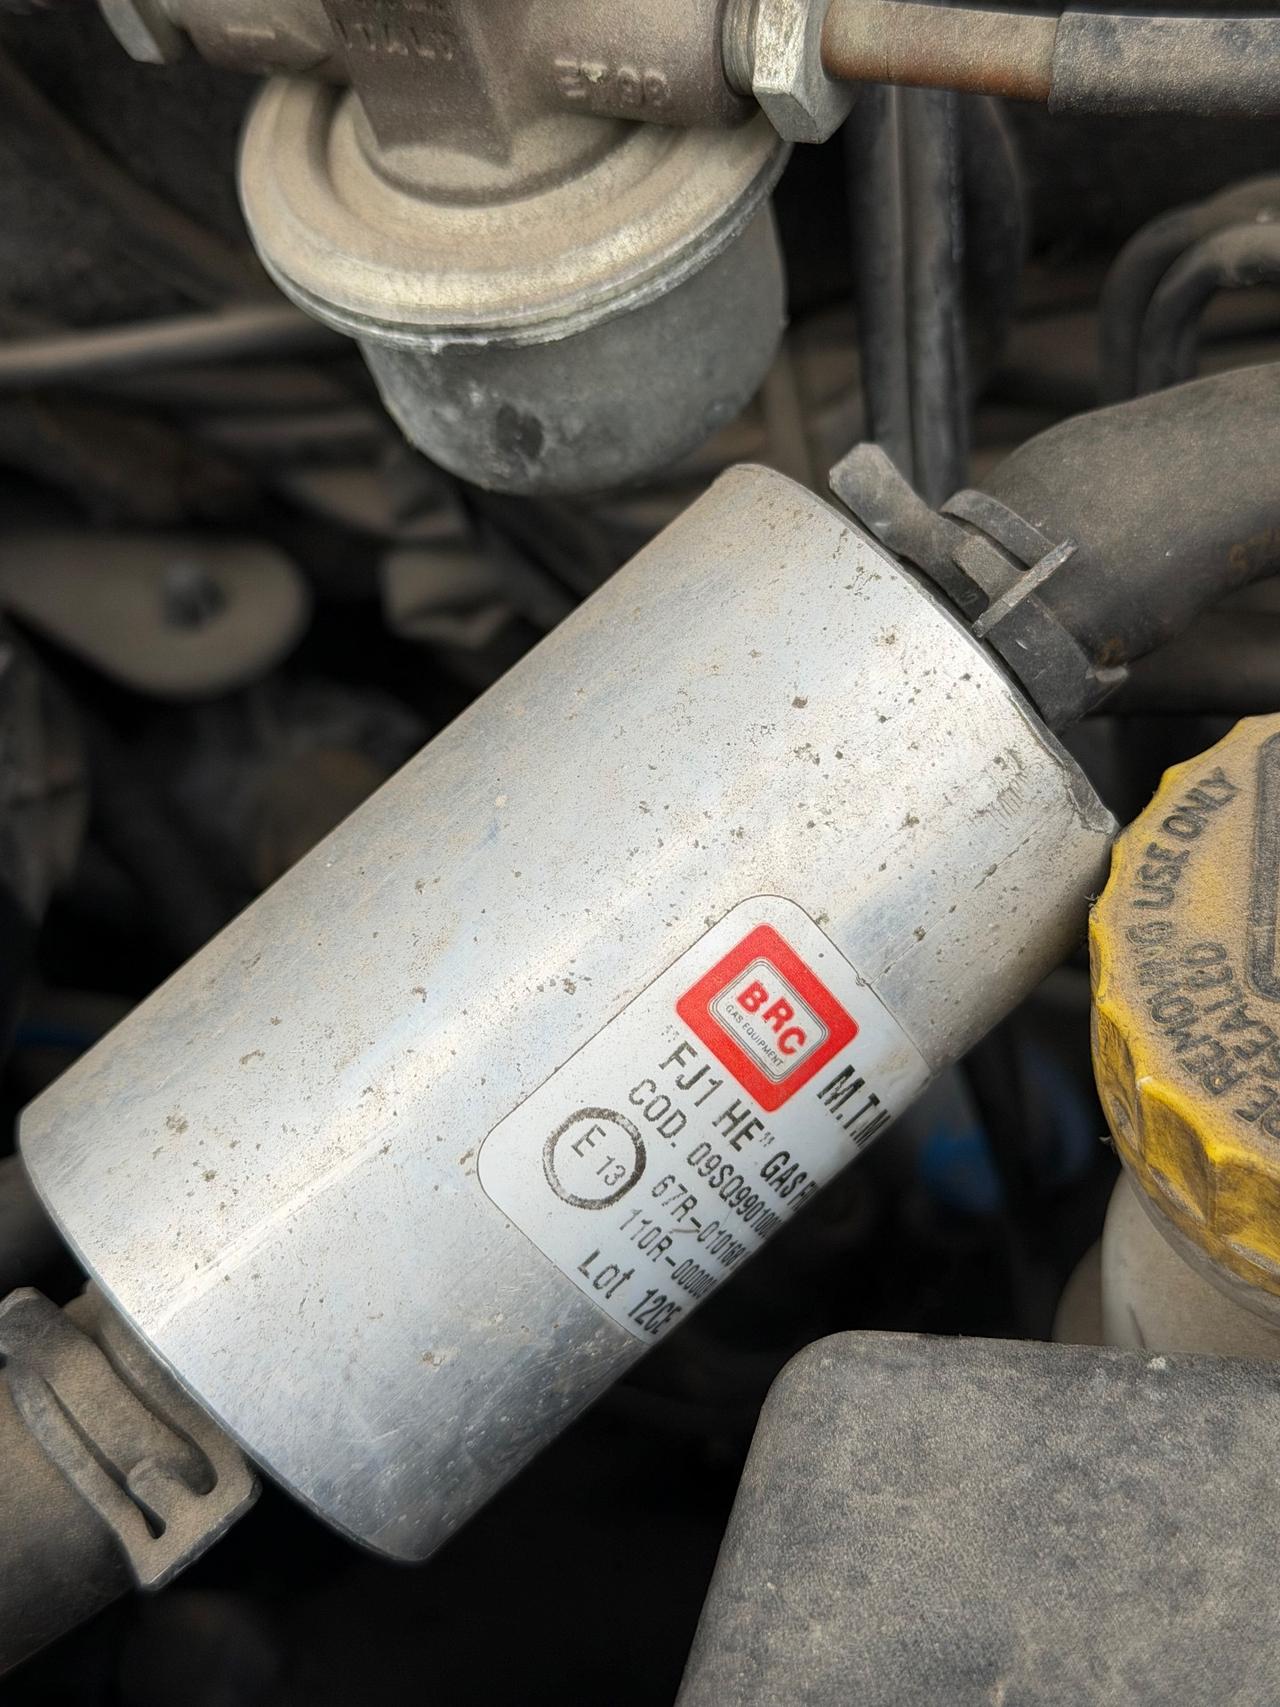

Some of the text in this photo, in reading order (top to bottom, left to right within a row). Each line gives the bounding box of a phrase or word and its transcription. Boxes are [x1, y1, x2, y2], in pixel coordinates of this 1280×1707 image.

[1133, 842, 1190, 909] USE
[1162, 766, 1240, 840] ONLY
[726, 1005, 784, 1067] GAS EQUIPMENT
[737, 981, 807, 1055] BRC
[571, 1124, 606, 1157] E
[628, 1078, 677, 1148] COD.
[595, 1155, 627, 1187] 13
[760, 1151, 808, 1198] GAS
[578, 1249, 635, 1299] Lot
